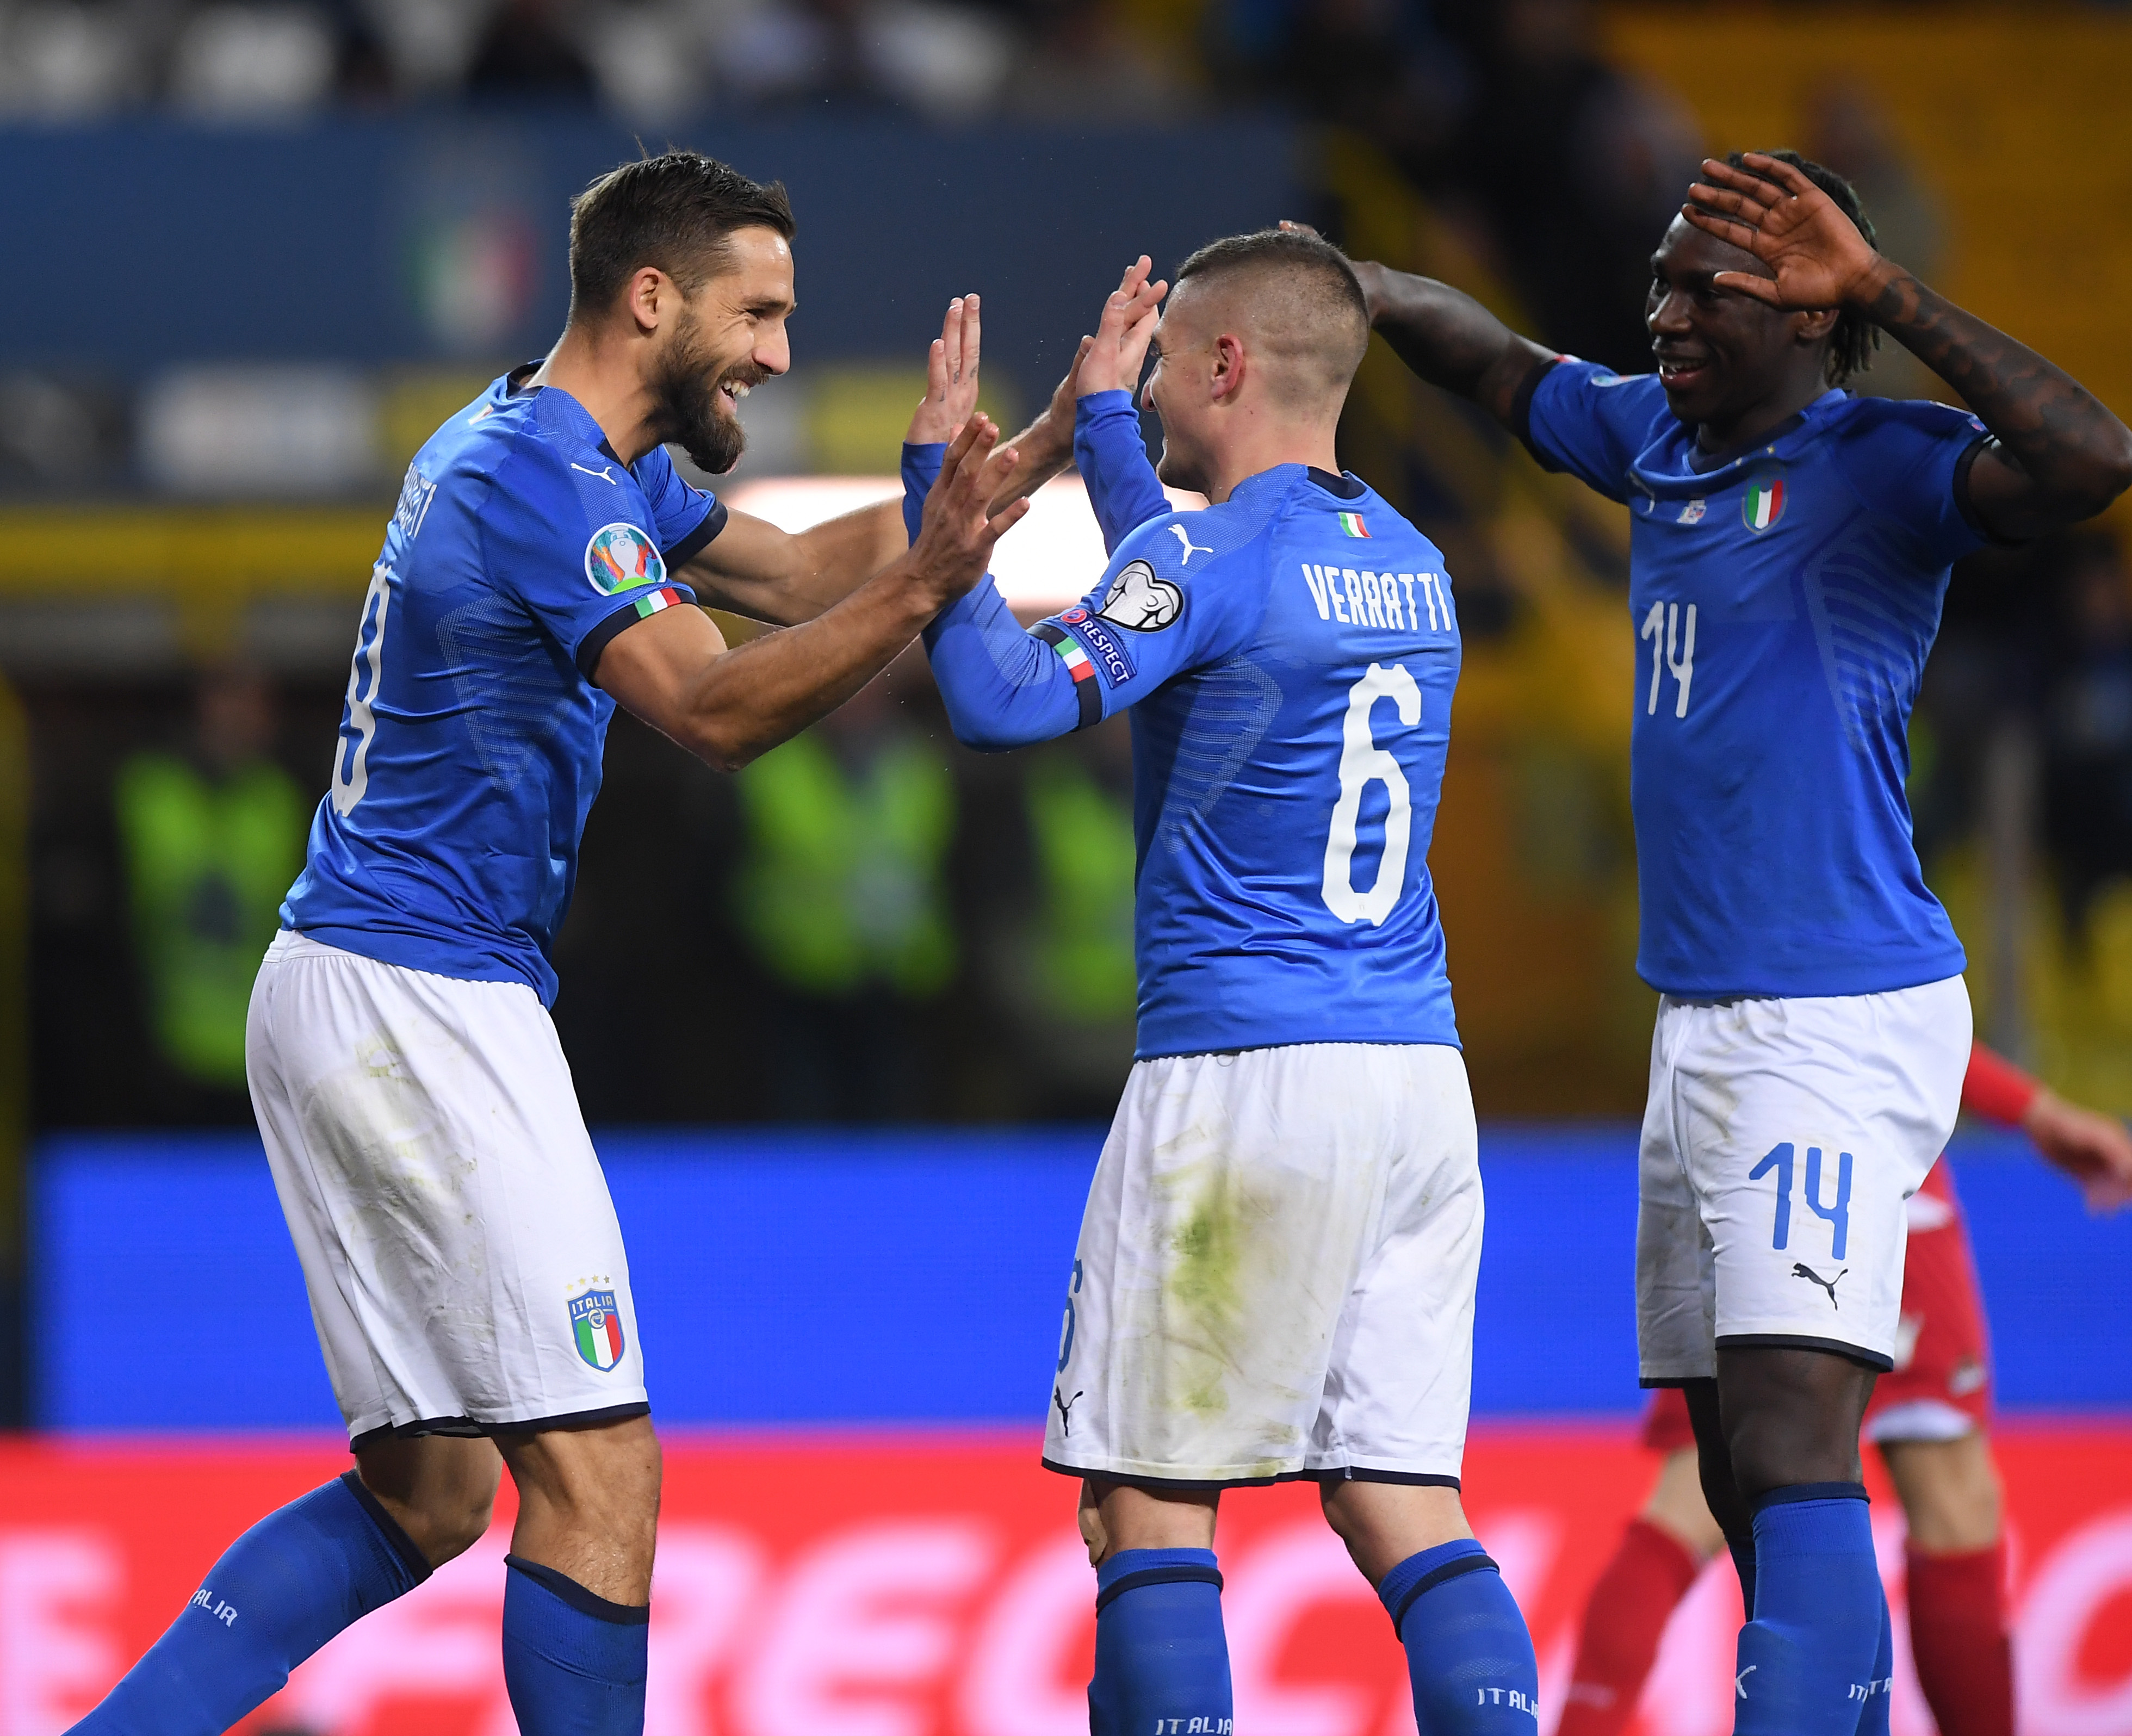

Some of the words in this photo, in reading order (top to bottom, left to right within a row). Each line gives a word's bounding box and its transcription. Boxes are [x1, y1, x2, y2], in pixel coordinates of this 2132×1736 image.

[1301, 563, 1452, 631] VERRATTI
[1079, 620, 1130, 682] RESPECT
[1641, 600, 1697, 718] 14
[332, 561, 391, 817] 9
[1321, 662, 1422, 927] 6
[1749, 1142, 1853, 1261] 14
[572, 1295, 613, 1315] ITALIA
[187, 1589, 238, 1628] ALIA
[1155, 1716, 1233, 1736] ITALIA
